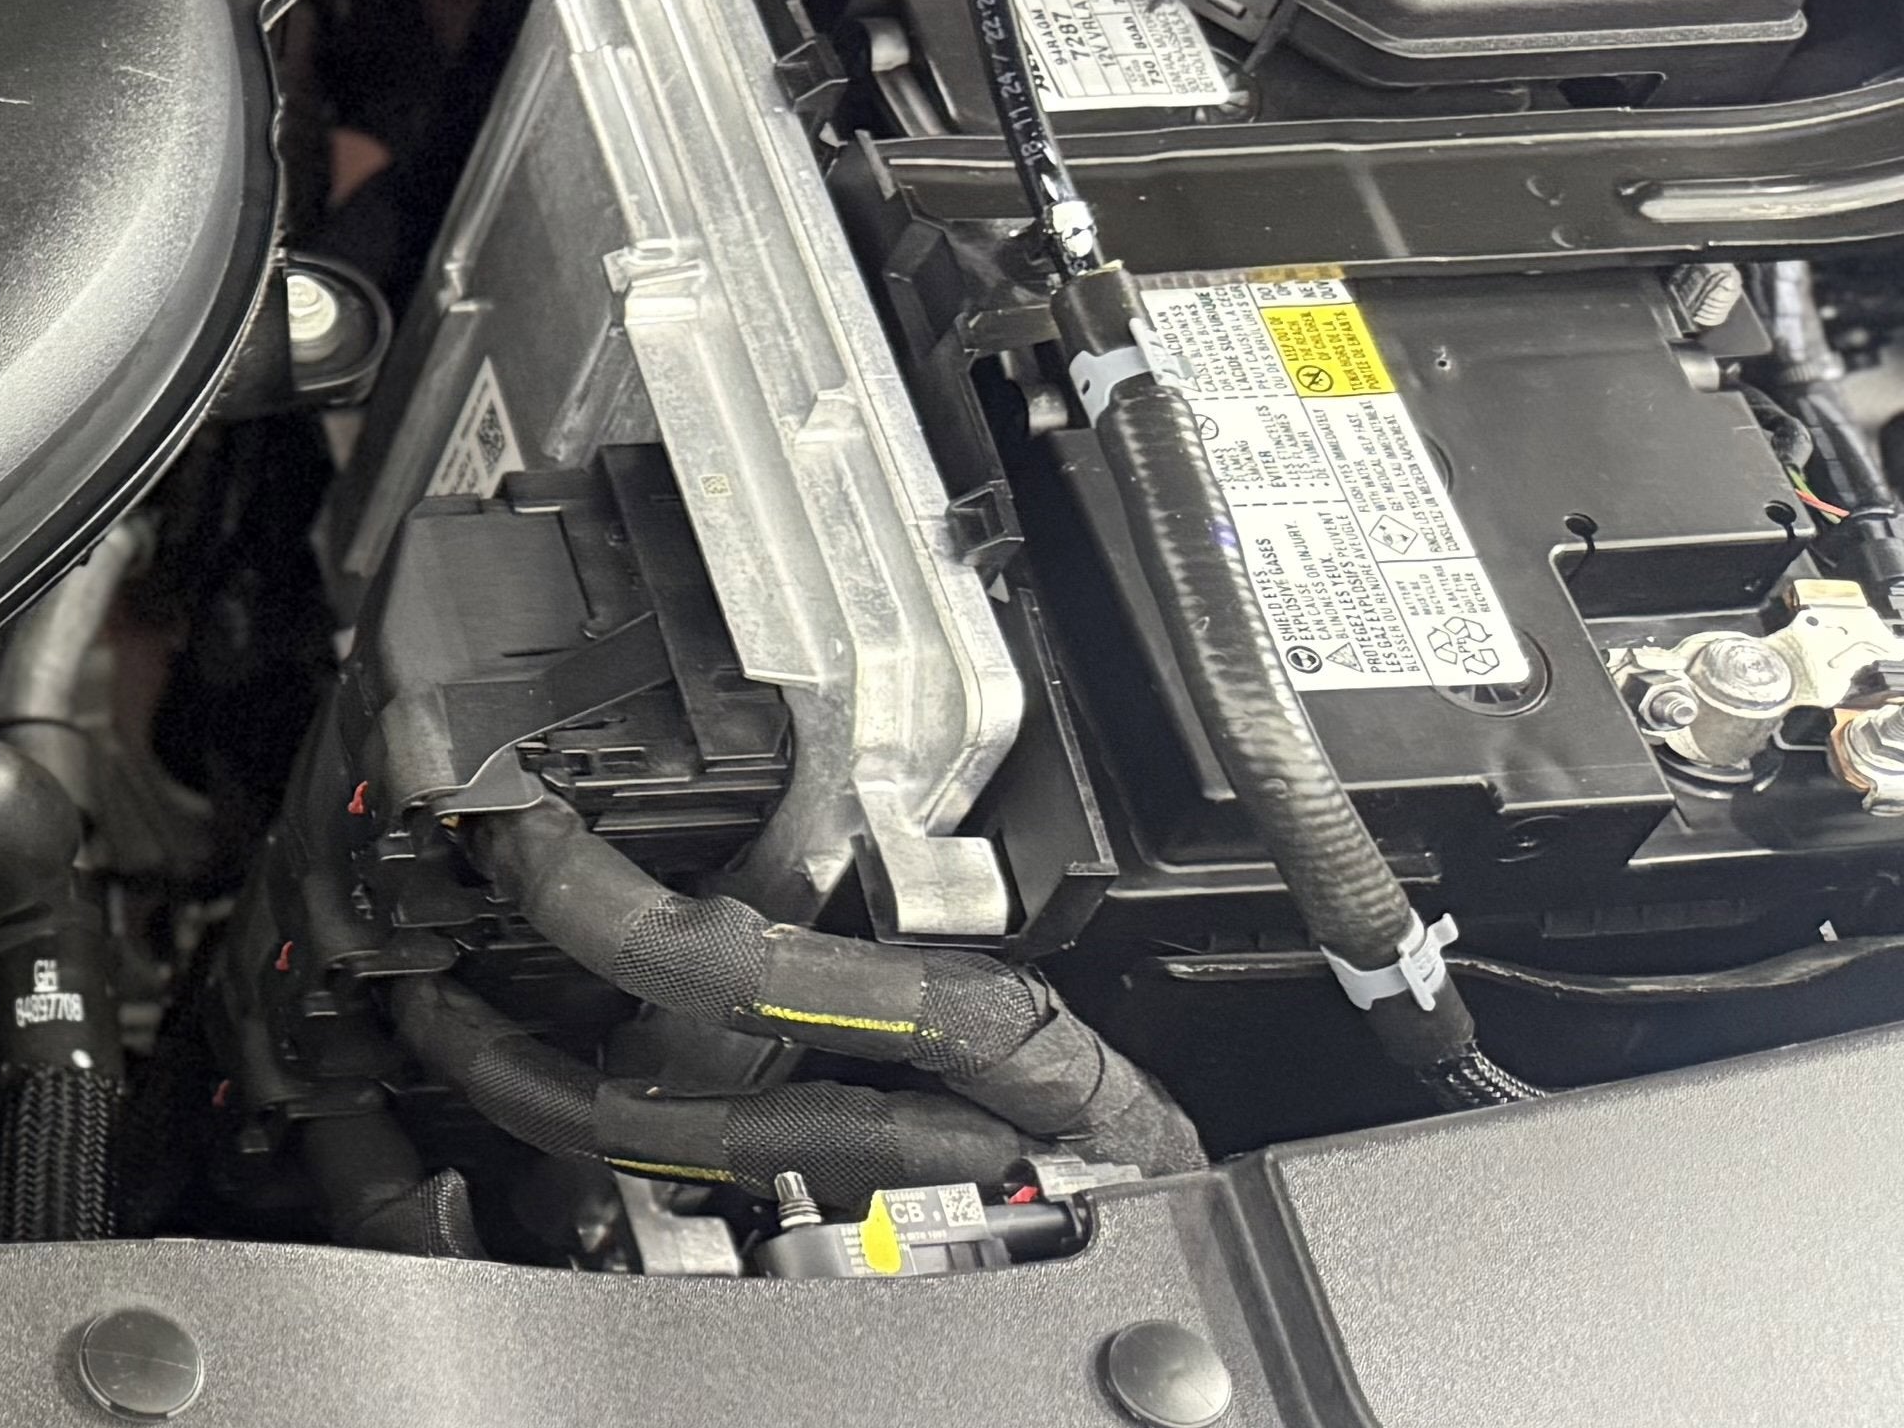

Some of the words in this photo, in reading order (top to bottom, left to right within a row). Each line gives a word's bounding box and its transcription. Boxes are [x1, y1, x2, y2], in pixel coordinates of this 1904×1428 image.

[1051, 11, 1091, 60] 7287
[1156, 311, 1174, 329] CAN
[1168, 304, 1203, 357] BLINDNESS
[1194, 291, 1235, 351] SULFURIQUE
[1321, 320, 1336, 331] LA
[1230, 324, 1259, 362] CAUSER
[1218, 378, 1235, 391] OR
[1248, 366, 1271, 389] PEUT
[1273, 413, 1304, 459] FLAMMES
[1282, 463, 1301, 480] LES
[1295, 462, 1315, 479] LES
[1312, 467, 1330, 479] DE
[1317, 511, 1350, 557] PEUVENT
[1335, 514, 1367, 559] AVEUGLE
[1255, 538, 1284, 574] GASES
[1302, 563, 1321, 577] OR
[1319, 552, 1345, 585] YEUX.
[1294, 583, 1321, 615] CAUSE
[1338, 560, 1380, 622] EXPLOSIFS
[1358, 564, 1388, 603] RENDRE
[1272, 579, 1315, 640] EXPLOSIVE
[1311, 581, 1349, 639] BLINDNESS
[1335, 590, 1357, 610] LES
[1379, 607, 1397, 621] OU
[1267, 602, 1297, 641] SHIELD
[1311, 618, 1332, 639] CAN
[1369, 626, 1393, 648] GAZ
[1381, 651, 1404, 672] LES
[1387, 625, 1420, 671] BLESSER
[890, 1201, 926, 1223] CB
